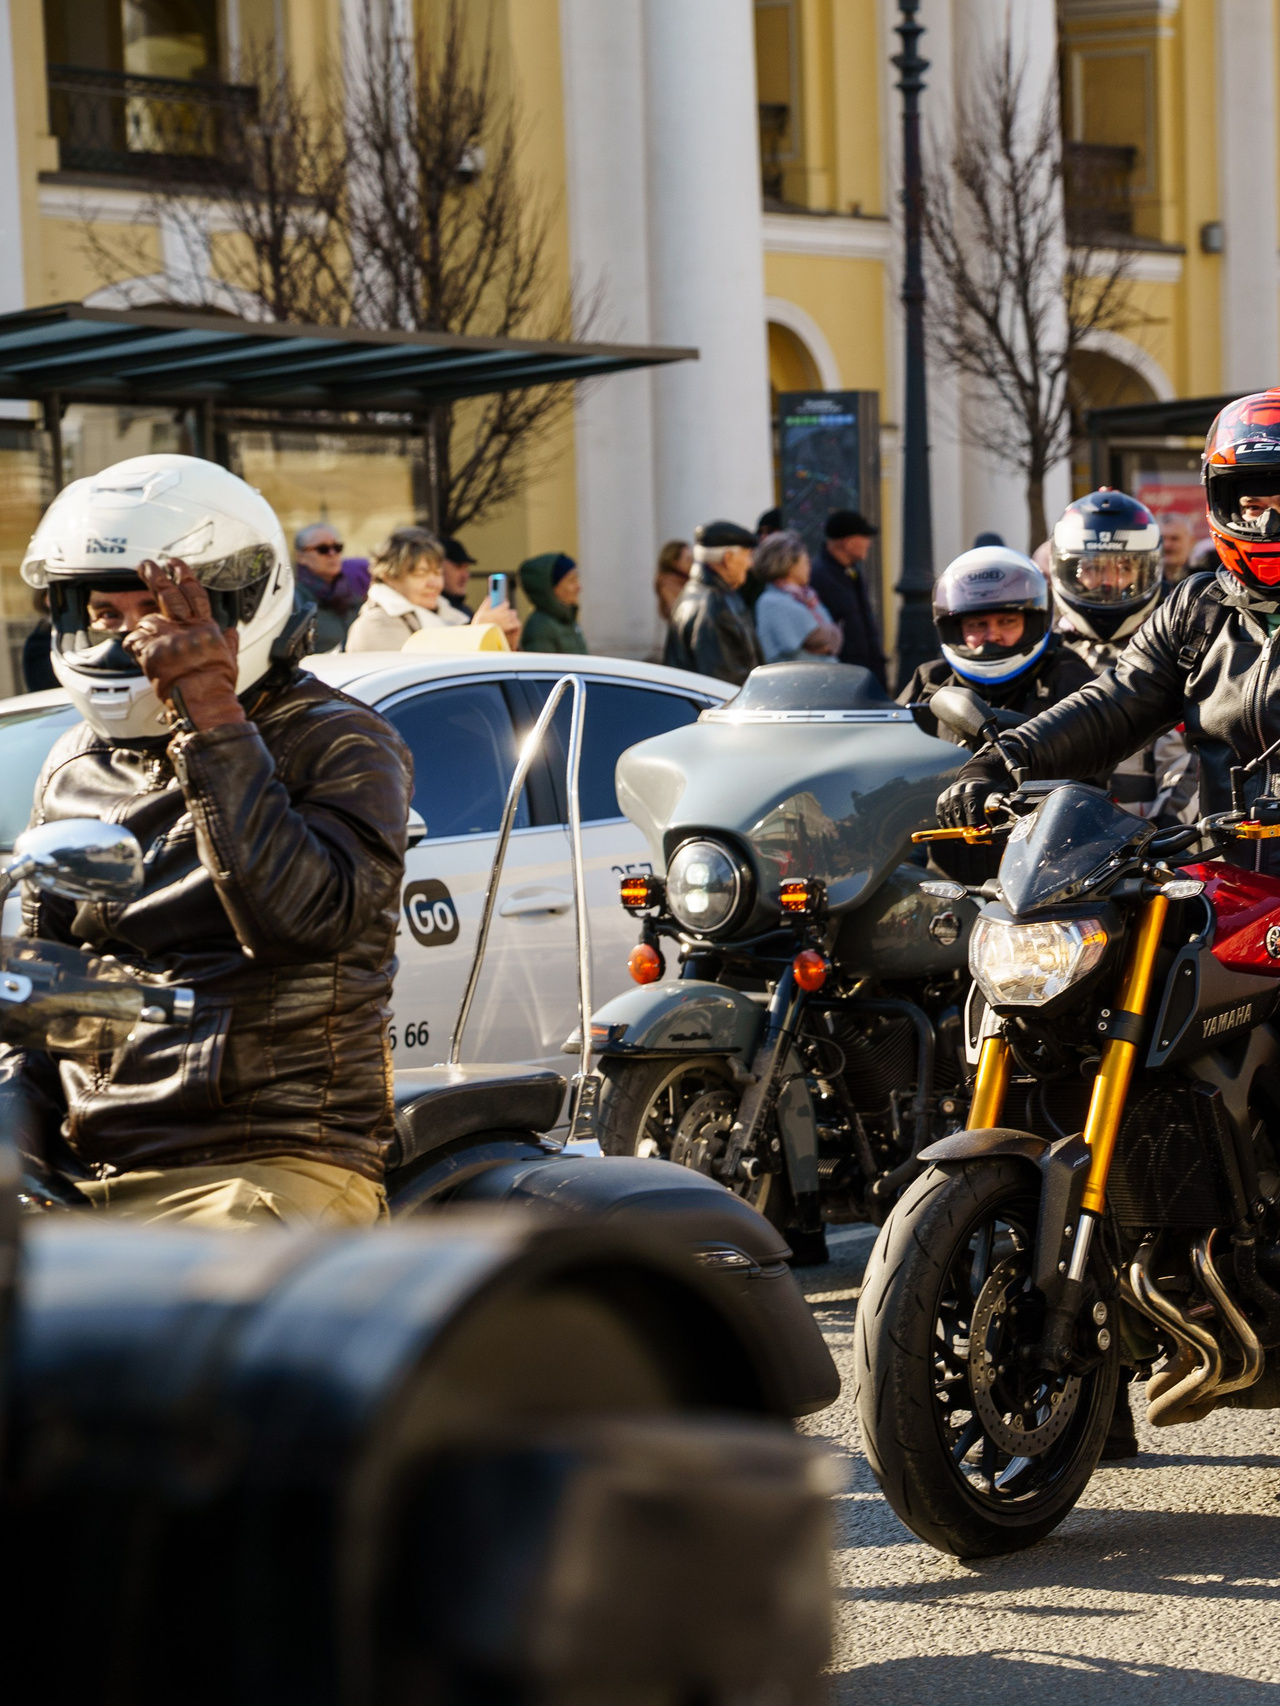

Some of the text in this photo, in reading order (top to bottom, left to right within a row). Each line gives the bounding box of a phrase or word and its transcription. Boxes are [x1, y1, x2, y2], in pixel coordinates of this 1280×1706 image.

[1086, 542, 1123, 550] SHARK
[409, 892, 454, 935] Go
[404, 1021, 430, 1048] 66
[1202, 1003, 1252, 1039] YAMAHA
